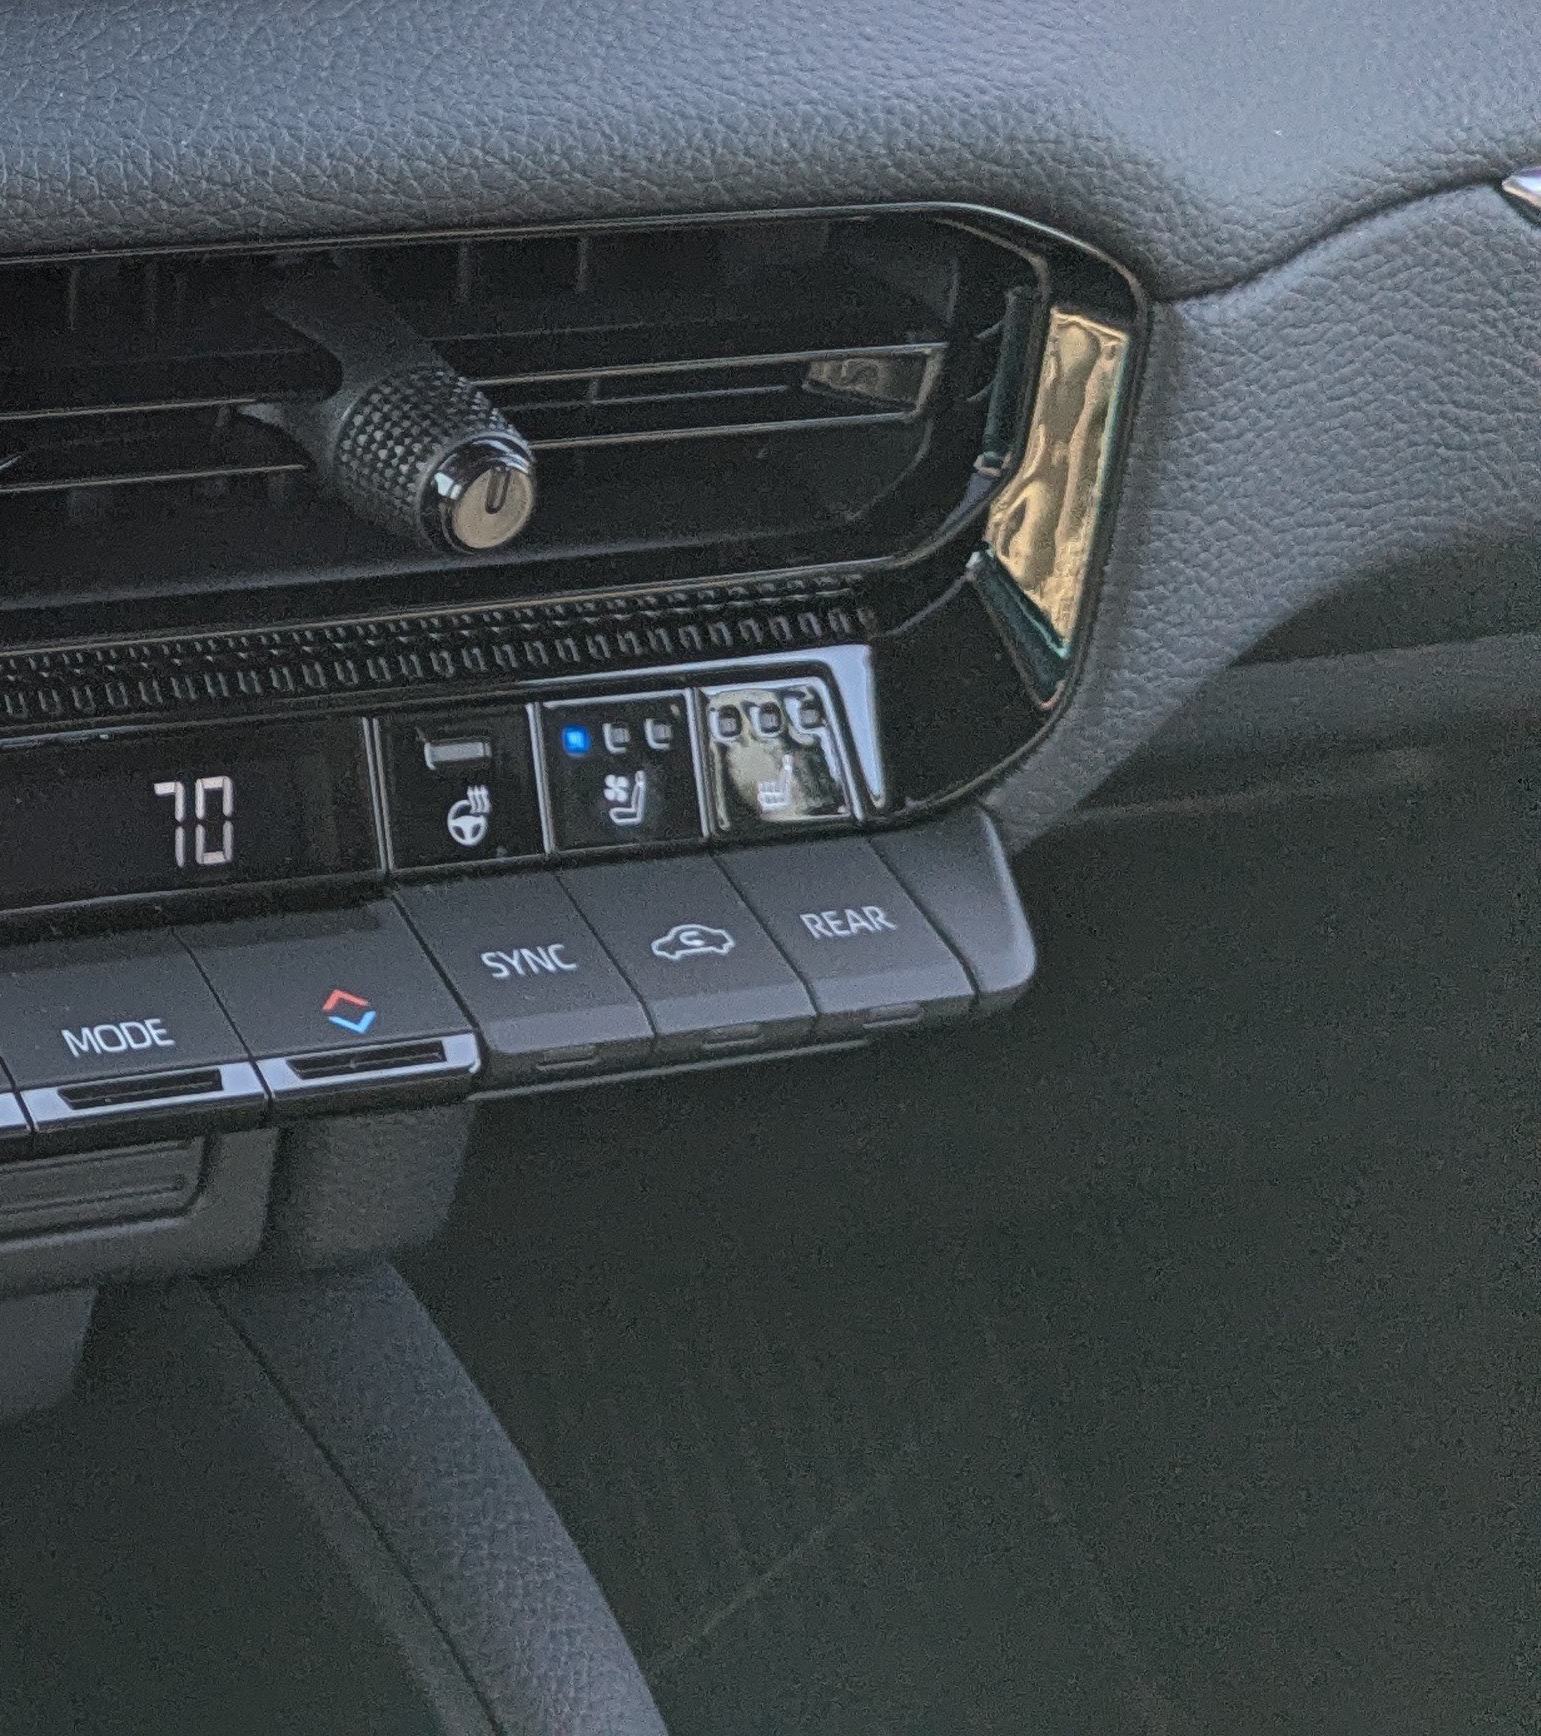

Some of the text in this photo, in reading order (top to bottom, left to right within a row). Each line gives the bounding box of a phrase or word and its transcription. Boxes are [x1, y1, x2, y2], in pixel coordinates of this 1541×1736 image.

[153, 775, 234, 867] 70
[801, 905, 896, 940] REAR
[481, 943, 577, 981] SYNC
[61, 1017, 175, 1060] MODE
